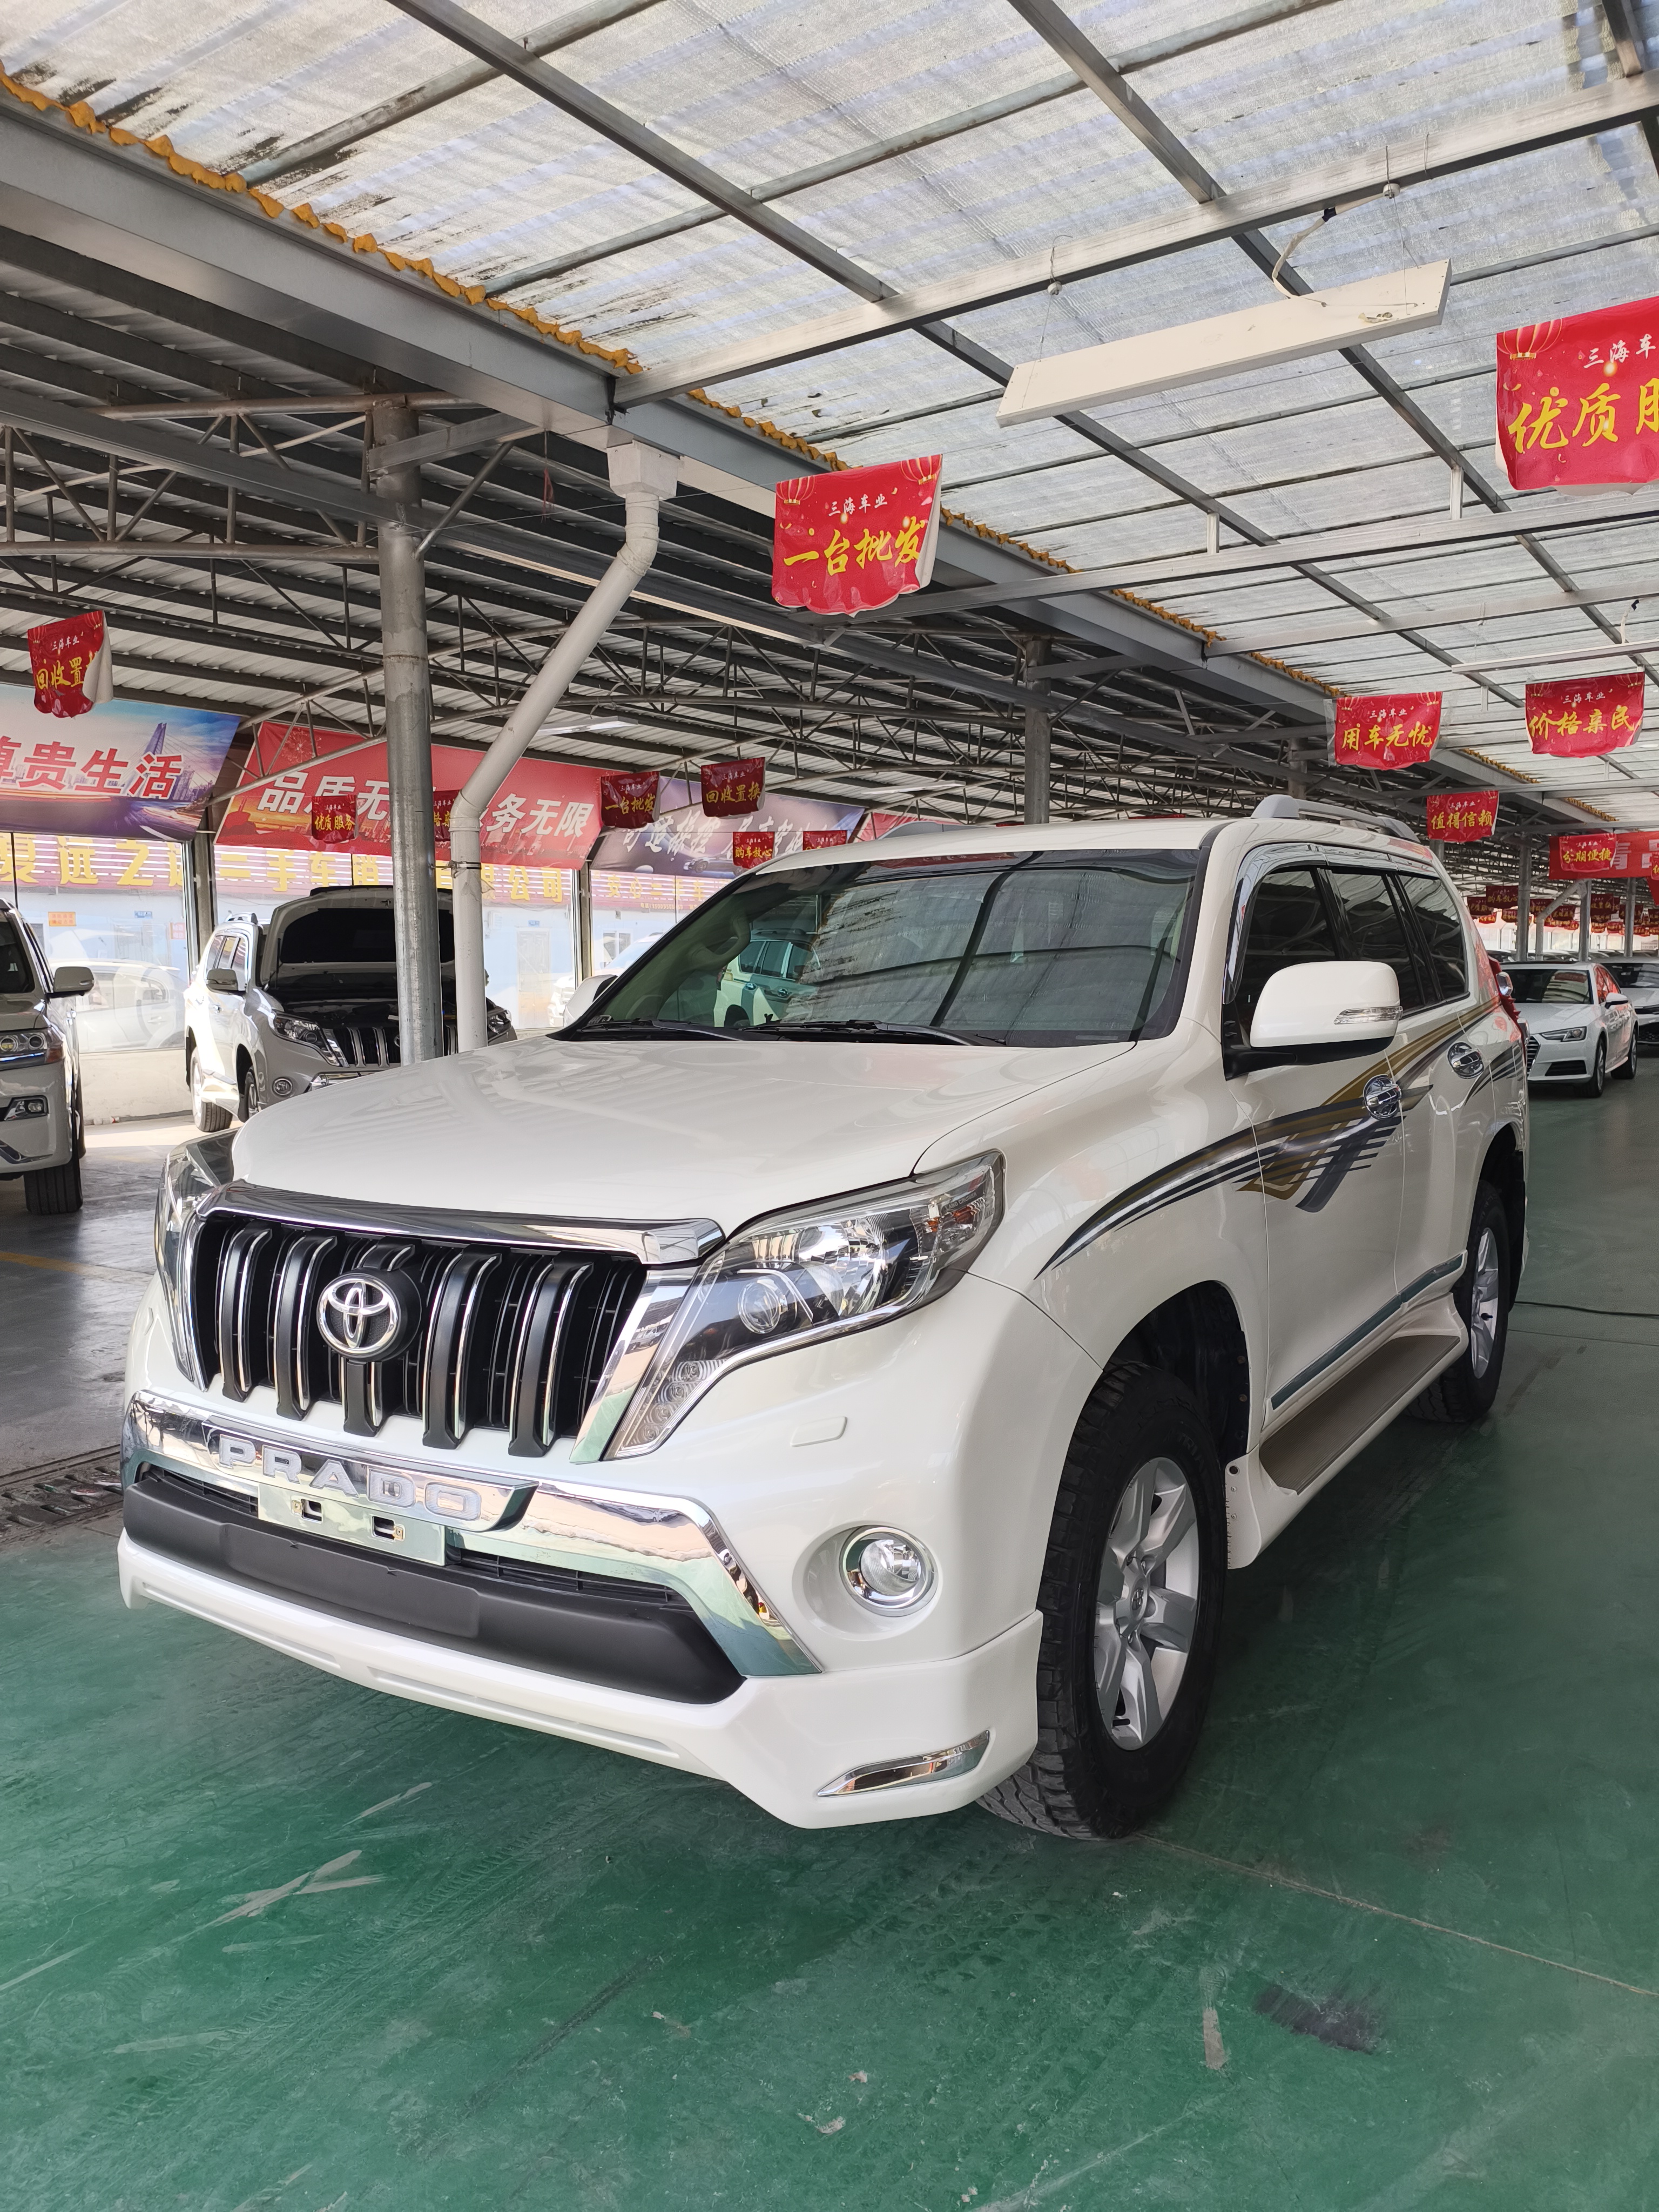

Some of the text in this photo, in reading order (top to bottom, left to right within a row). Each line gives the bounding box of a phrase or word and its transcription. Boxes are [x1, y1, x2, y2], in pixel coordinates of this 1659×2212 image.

[828, 493, 888, 516] 三海车业
[784, 516, 926, 576] 一台批发
[36, 650, 98, 690] 回收置
[1562, 691, 1606, 704] 三海车业
[1369, 708, 1407, 719] 三海车业
[1528, 705, 1636, 740] 价格亲民
[1341, 723, 1433, 751] 用车无忧
[604, 793, 656, 814] 一台批发
[706, 782, 761, 804] 回收置换
[314, 813, 356, 831] 优质服务
[480, 793, 595, 838] 务无限
[1431, 810, 1493, 830] 值得信赖
[735, 846, 773, 859] 购车放心
[945, 1192, 978, 1211] LAND CRUISER
[218, 1433, 482, 1522] PRADO
